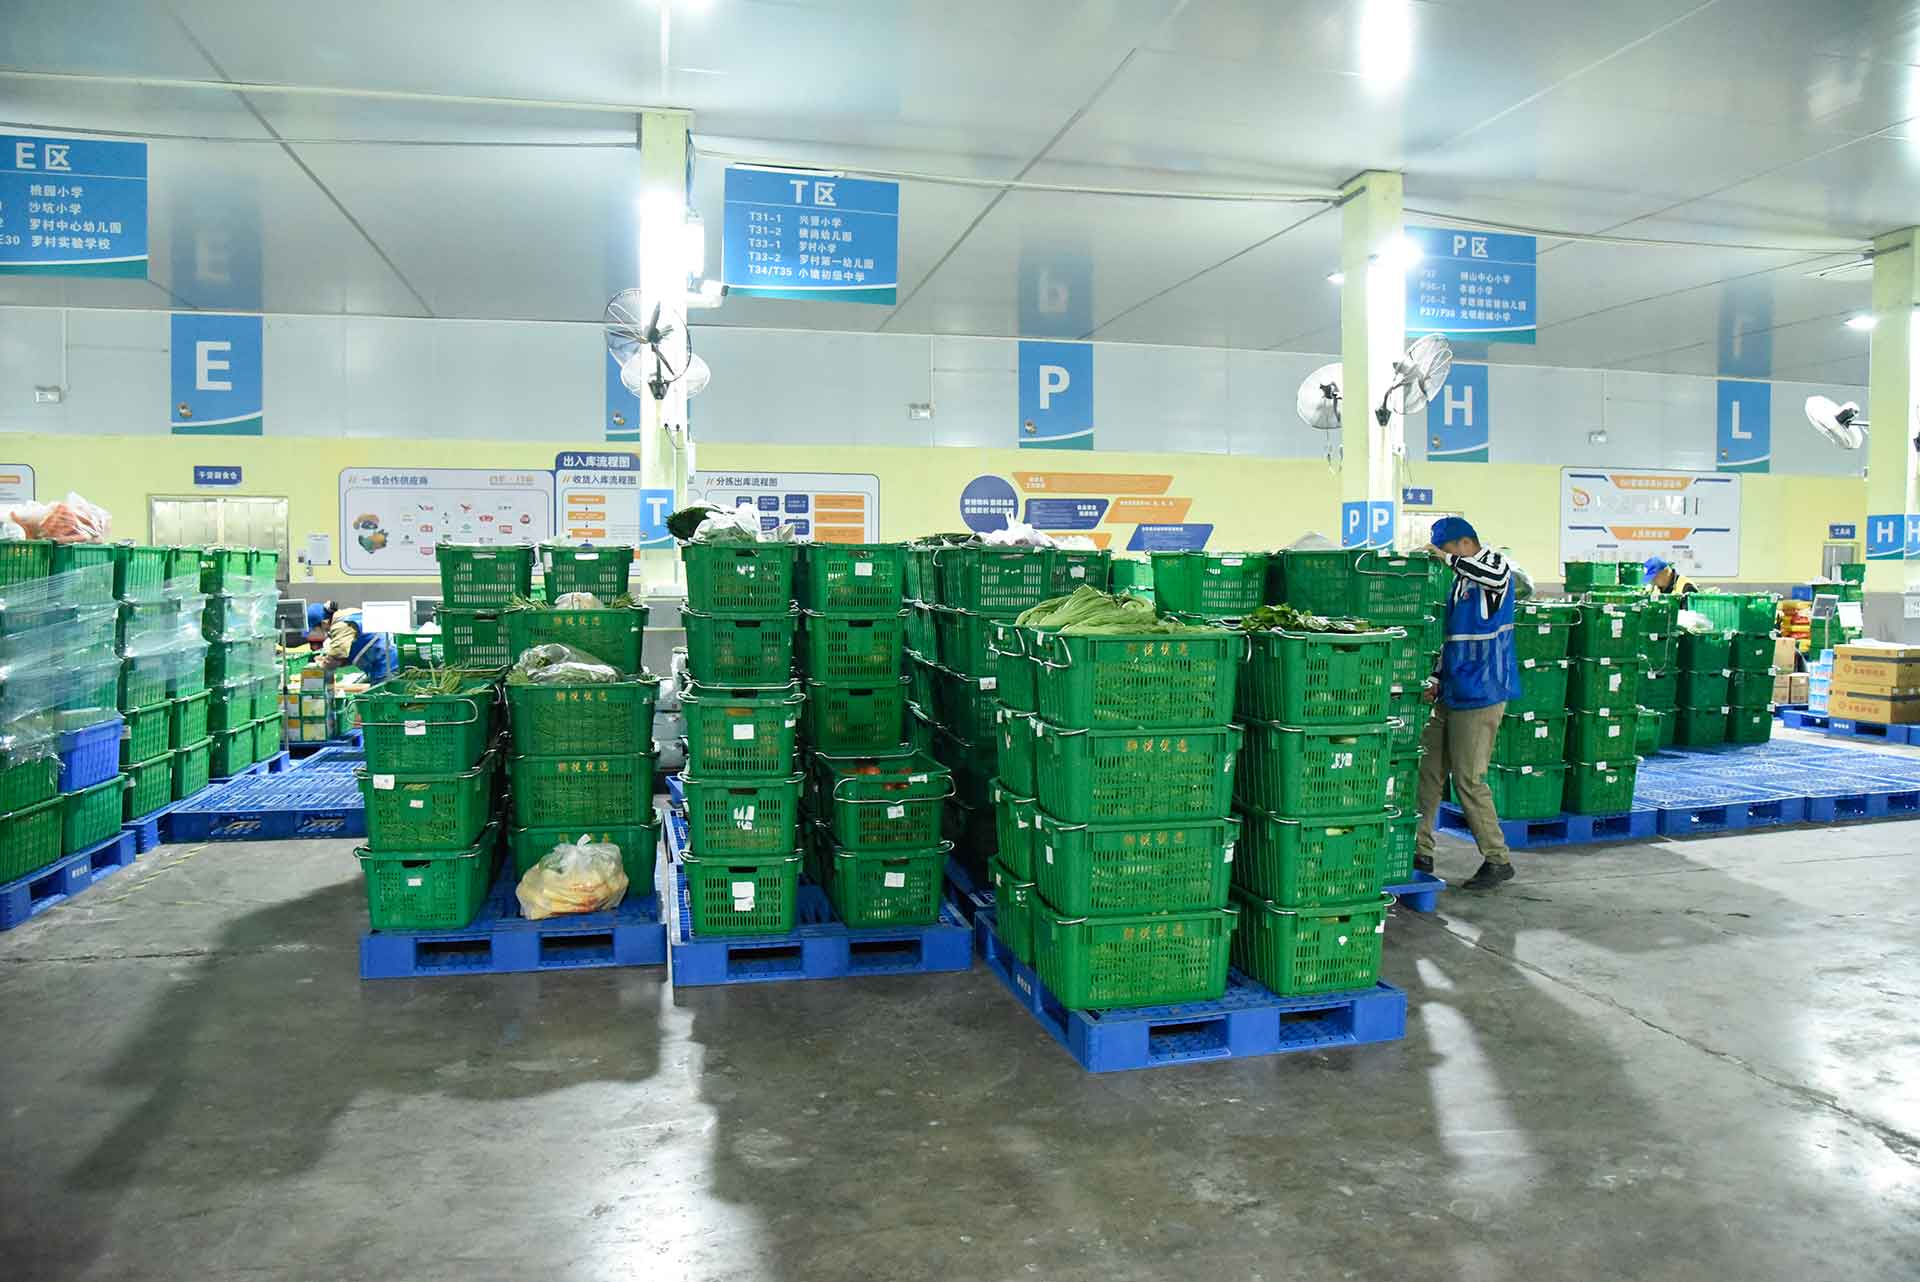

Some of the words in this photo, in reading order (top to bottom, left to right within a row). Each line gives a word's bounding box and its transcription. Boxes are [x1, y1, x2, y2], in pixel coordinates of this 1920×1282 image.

[748, 211, 782, 223] T31-1
[196, 341, 233, 391] E
[1039, 365, 1071, 410] P
[1443, 384, 1473, 427] H
[1731, 399, 1753, 440] L
[562, 455, 631, 469] 出入库流程图
[645, 496, 669, 527] T
[1348, 509, 1361, 534] P
[1371, 507, 1390, 534] P
[1876, 520, 1895, 543] H
